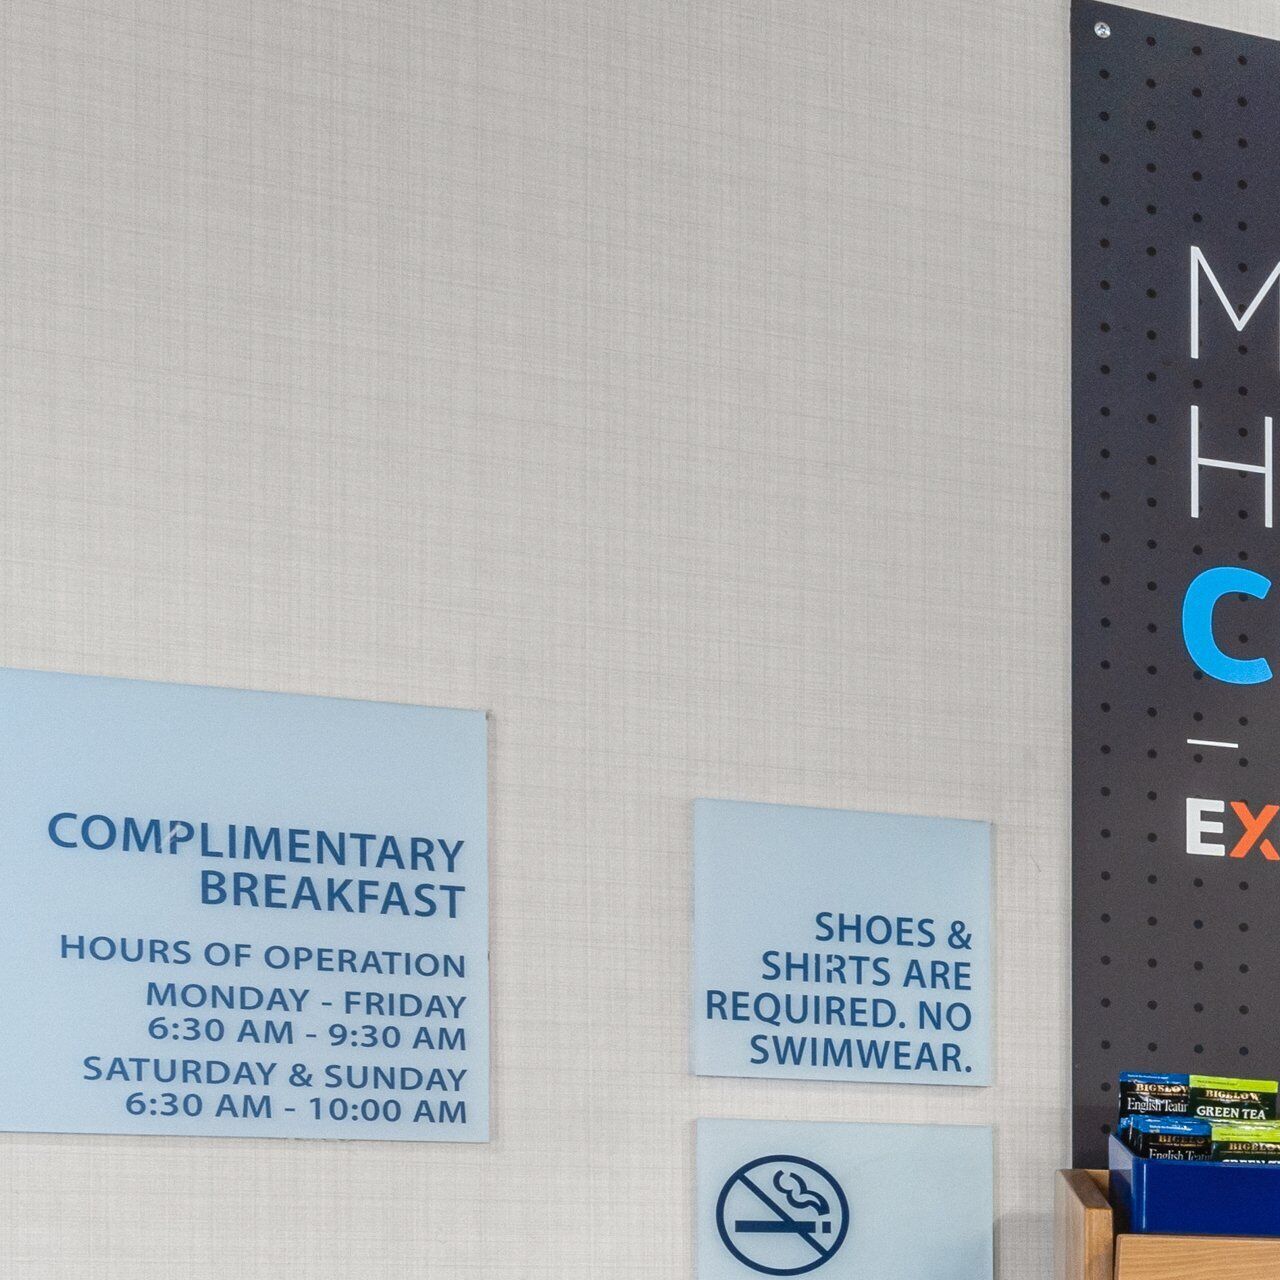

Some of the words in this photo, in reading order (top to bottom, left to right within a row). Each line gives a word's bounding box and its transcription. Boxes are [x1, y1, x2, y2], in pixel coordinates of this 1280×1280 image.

[47, 812, 465, 873] COMPLIMENTARY
[200, 869, 466, 919] BREAKFAST
[815, 911, 936, 947] SHOES
[947, 920, 973, 950] &
[60, 934, 191, 965] HOURS
[204, 941, 251, 968] OF
[264, 945, 466, 978] OPERATION
[762, 951, 891, 986] SHIRTS
[903, 959, 972, 990] ARE
[147, 982, 310, 1012] MONDAY
[345, 991, 467, 1019] FRIDAY
[706, 990, 906, 1029] REQUIRED.
[919, 1001, 972, 1031] NO
[148, 1016, 224, 1042] 6:30
[237, 1020, 294, 1045] AM
[328, 1023, 400, 1048] 9:30
[412, 1026, 466, 1051] AM
[750, 1034, 972, 1073] SWIMWEAR.
[83, 1055, 277, 1086] SATURDAY
[289, 1063, 313, 1087] &
[324, 1064, 468, 1091] SUNDAY
[125, 1091, 203, 1117] 6:30
[215, 1094, 272, 1118] AM
[309, 1097, 401, 1121] 10:00
[413, 1099, 467, 1124] AM
[1127, 1097, 1164, 1114] English
[1196, 1105, 1240, 1119] GREEN
[1242, 1108, 1266, 1120] TEA
[1205, 1089, 1260, 1101] BIGELOW
[1158, 1135, 1208, 1144] BIGELO
